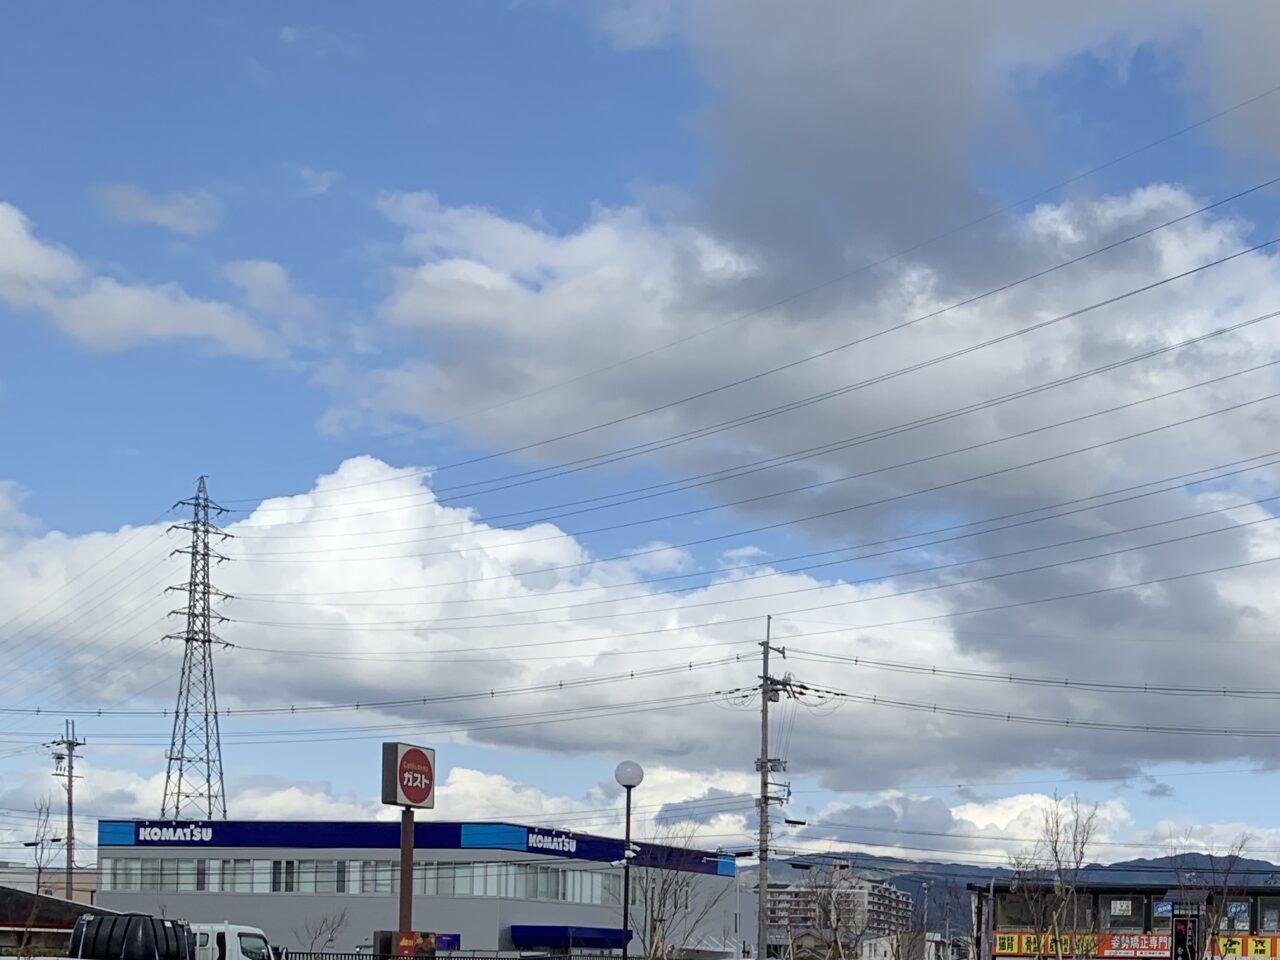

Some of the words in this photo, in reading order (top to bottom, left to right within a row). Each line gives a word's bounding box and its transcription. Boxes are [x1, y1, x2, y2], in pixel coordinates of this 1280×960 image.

[403, 771, 430, 789] ガスト
[139, 824, 213, 841] KOMATSU
[528, 834, 577, 852] KOMATSU
